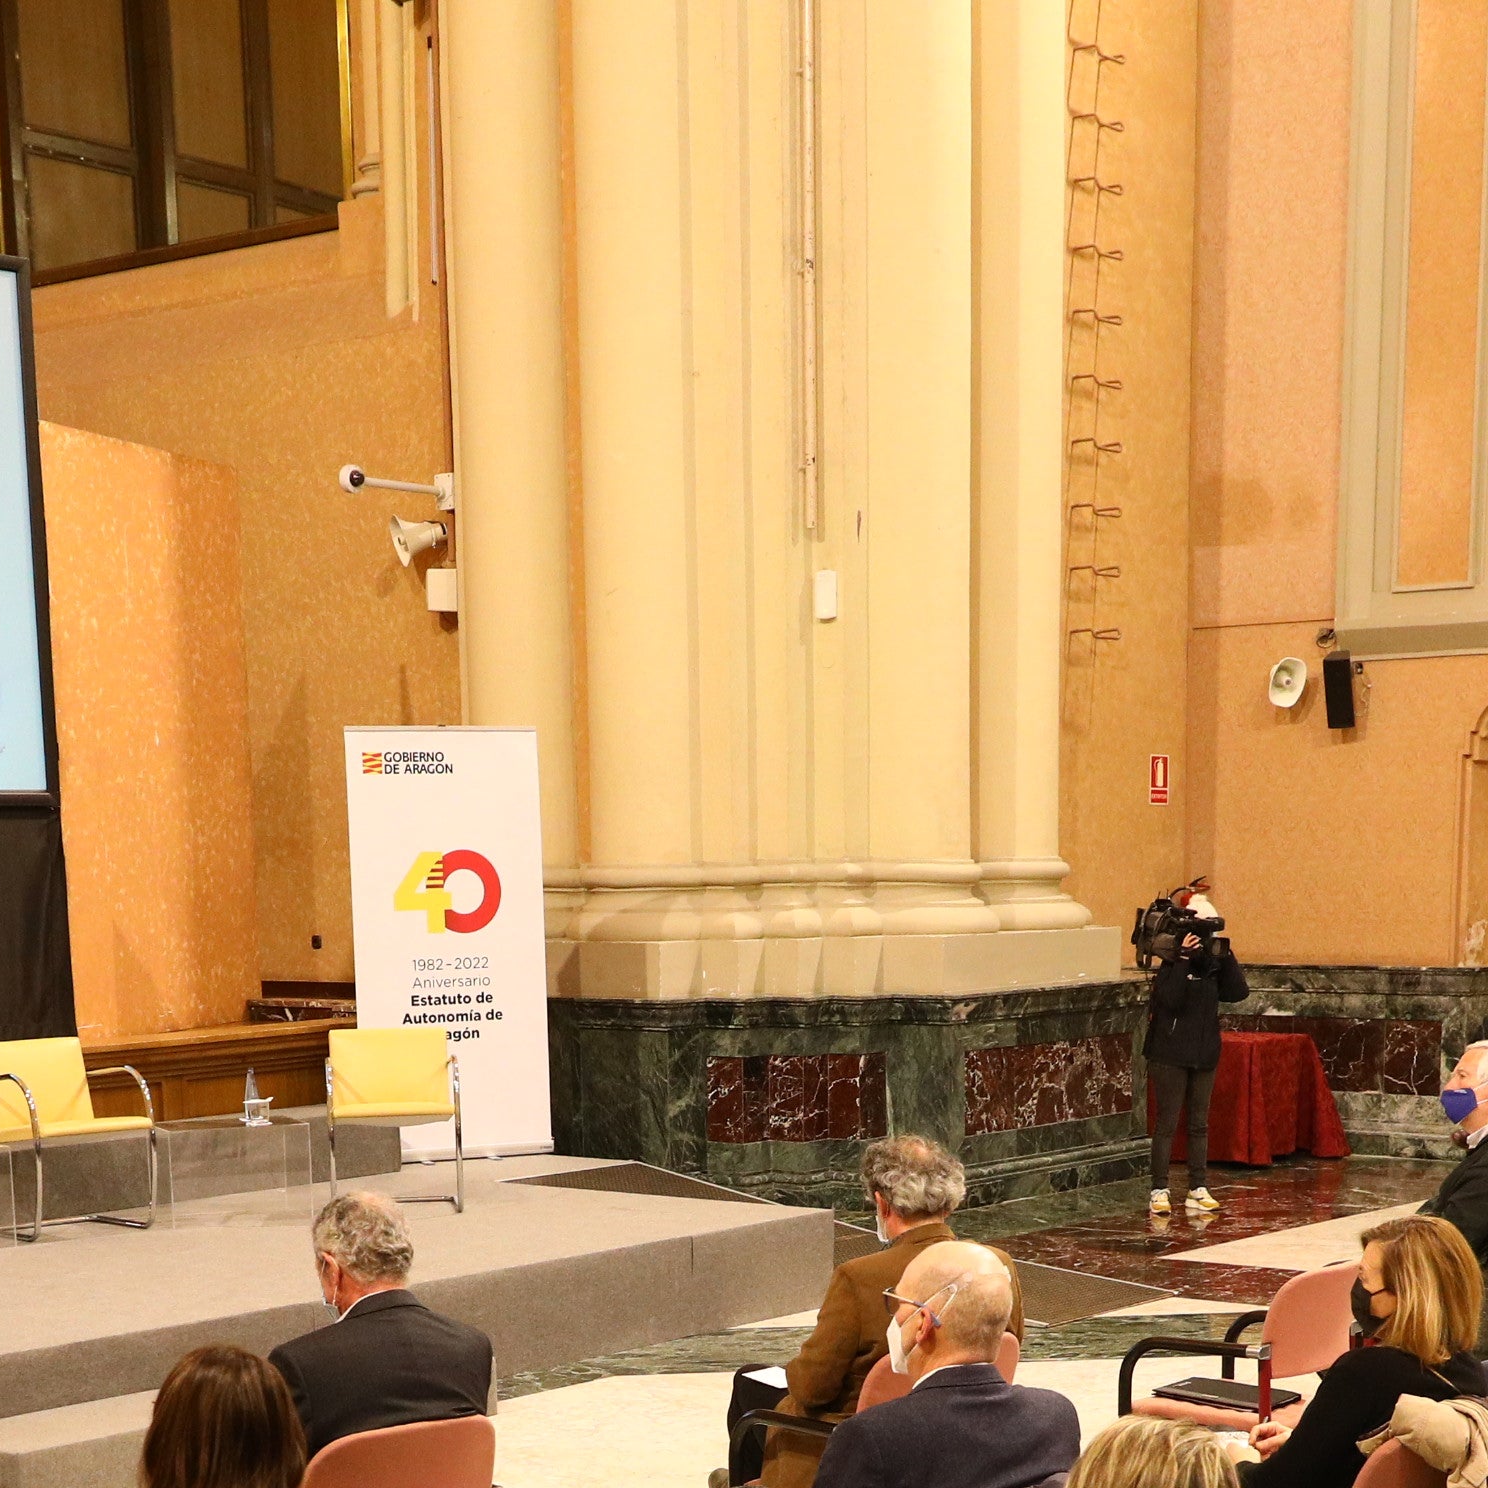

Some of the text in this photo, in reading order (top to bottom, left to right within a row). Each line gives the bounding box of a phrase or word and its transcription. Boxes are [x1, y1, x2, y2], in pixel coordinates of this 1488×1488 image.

[384, 751, 445, 763] GOBIERNO
[384, 763, 453, 775] DE ARAGON
[393, 849, 502, 934] 40
[412, 975, 491, 990] Aniversario
[411, 992, 494, 1007] Estatuto de
[402, 1008, 503, 1025] Autonomía de
